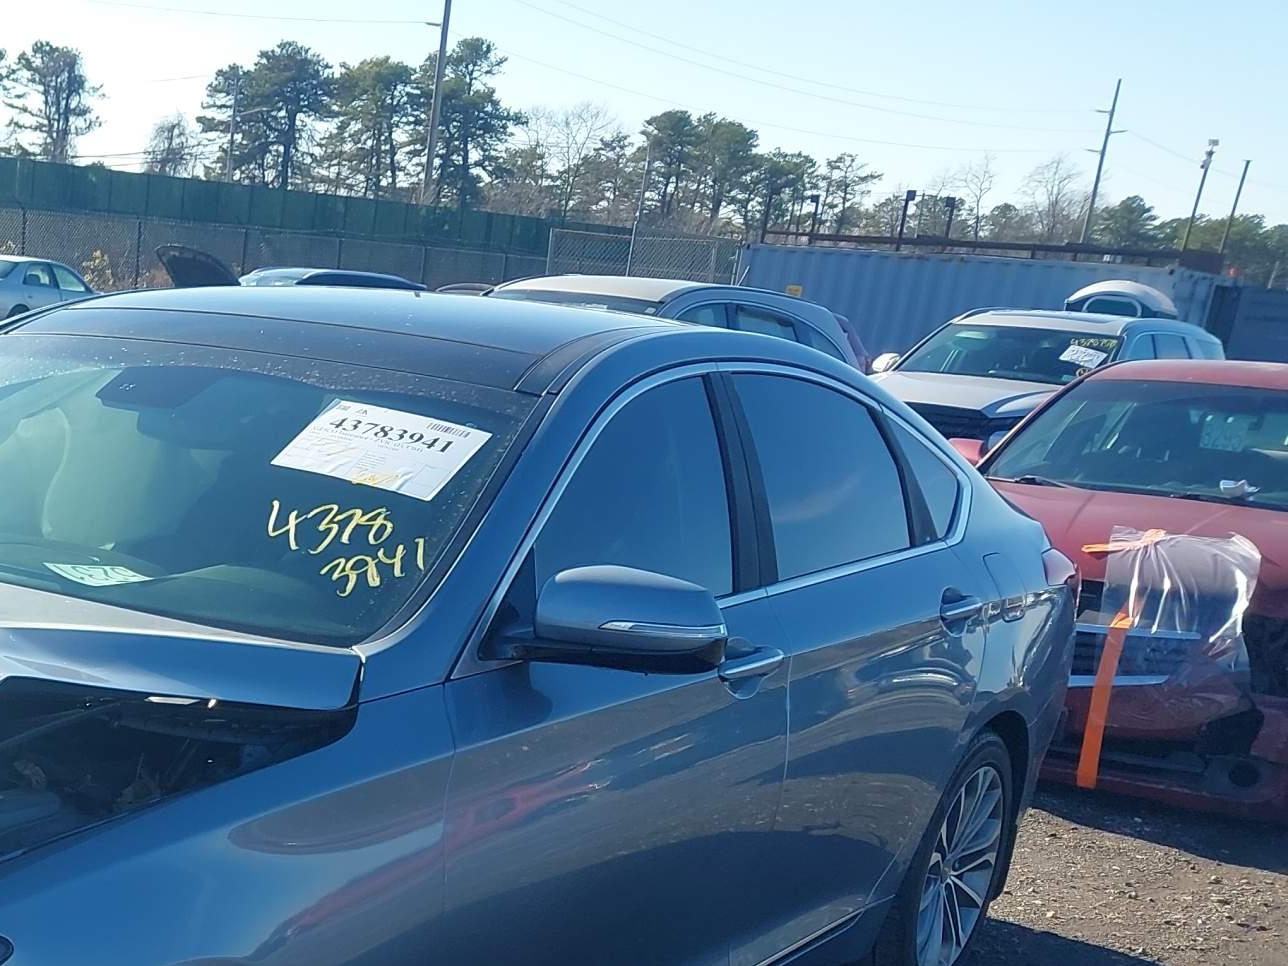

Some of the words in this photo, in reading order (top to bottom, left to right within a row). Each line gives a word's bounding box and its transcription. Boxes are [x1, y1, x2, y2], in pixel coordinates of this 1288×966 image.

[329, 417, 454, 453] 43783941
[267, 500, 393, 555] 4378
[320, 538, 425, 597] 3941
